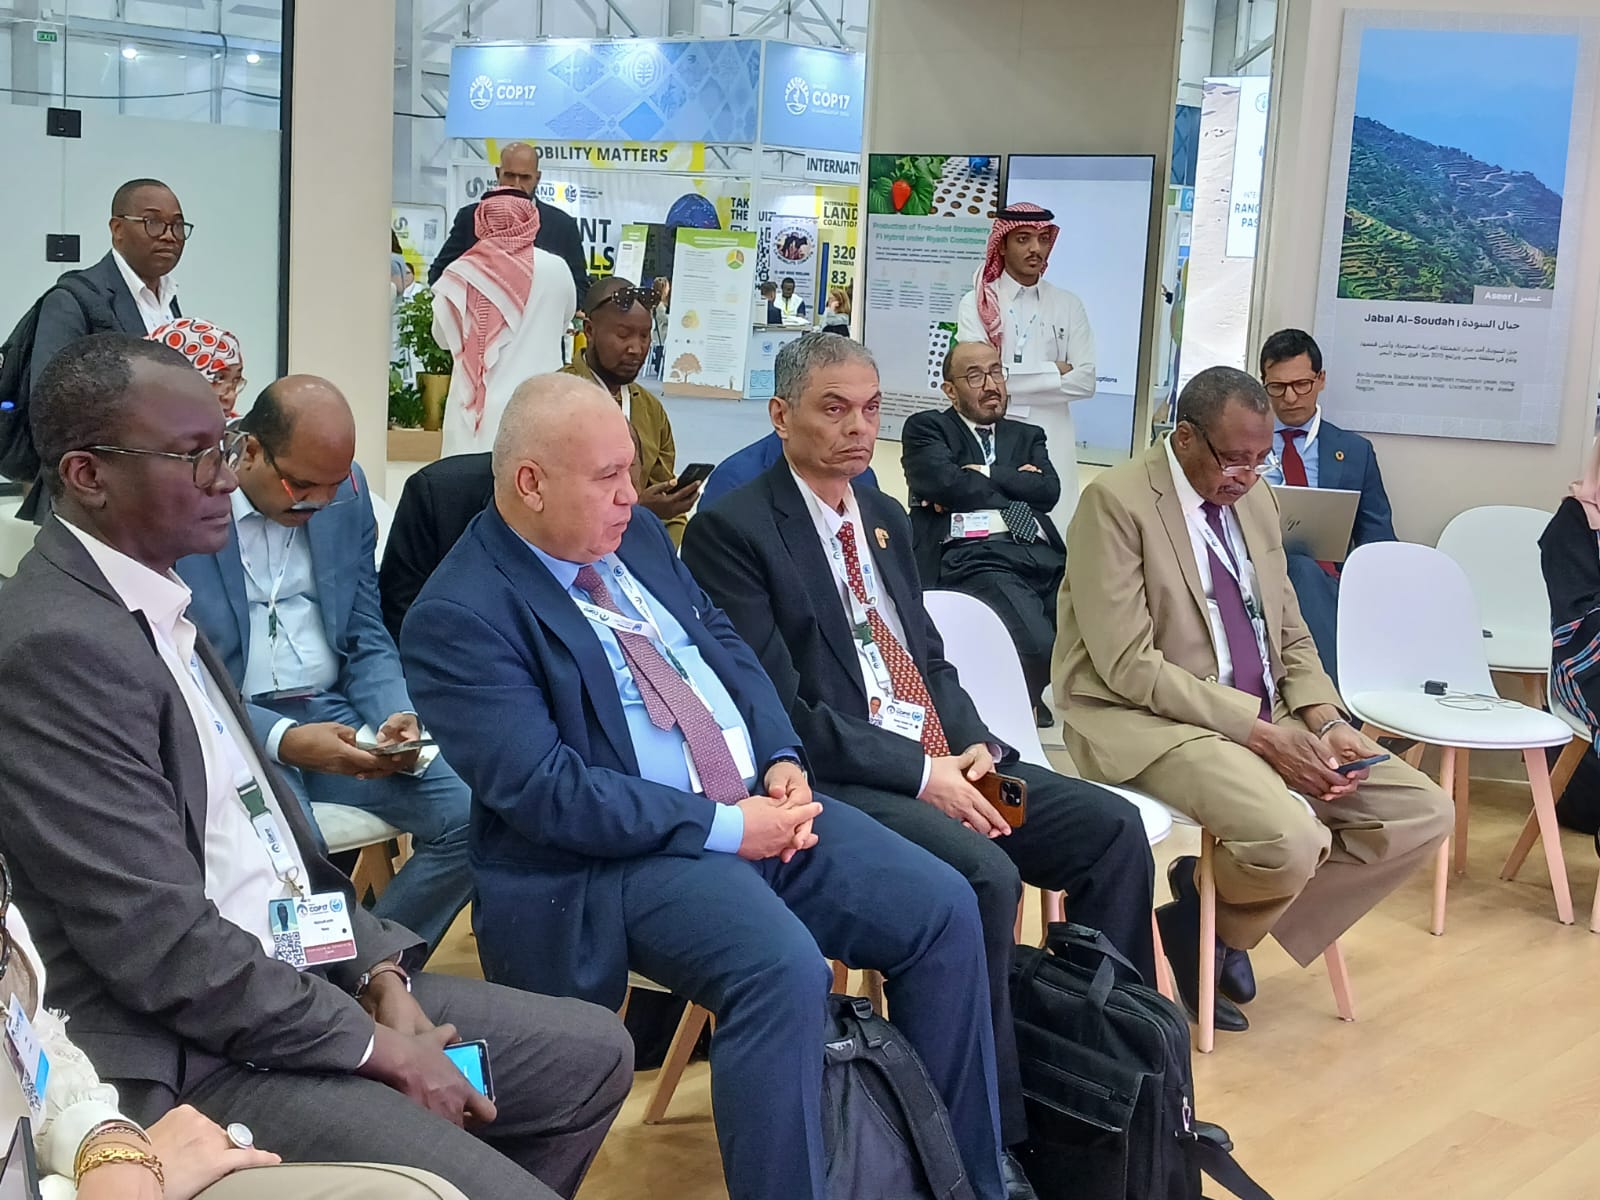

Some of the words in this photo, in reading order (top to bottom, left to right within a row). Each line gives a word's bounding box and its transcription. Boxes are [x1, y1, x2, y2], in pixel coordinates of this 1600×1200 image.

[496, 85, 536, 99] COP17
[812, 91, 850, 109] COP17
[535, 146, 592, 160] OBILITY
[597, 147, 668, 162] MATTERS
[807, 157, 860, 175] INTERNATI
[730, 197, 750, 209] TAK
[730, 209, 749, 221] THE
[823, 206, 858, 220] LAND
[580, 218, 611, 243] NT
[909, 223, 916, 231] of
[589, 245, 615, 271] LS
[833, 245, 856, 260] 320
[831, 270, 847, 285] 83
[1364, 313, 1394, 323] Jabal
[1396, 314, 1455, 326] Al-Soudah
